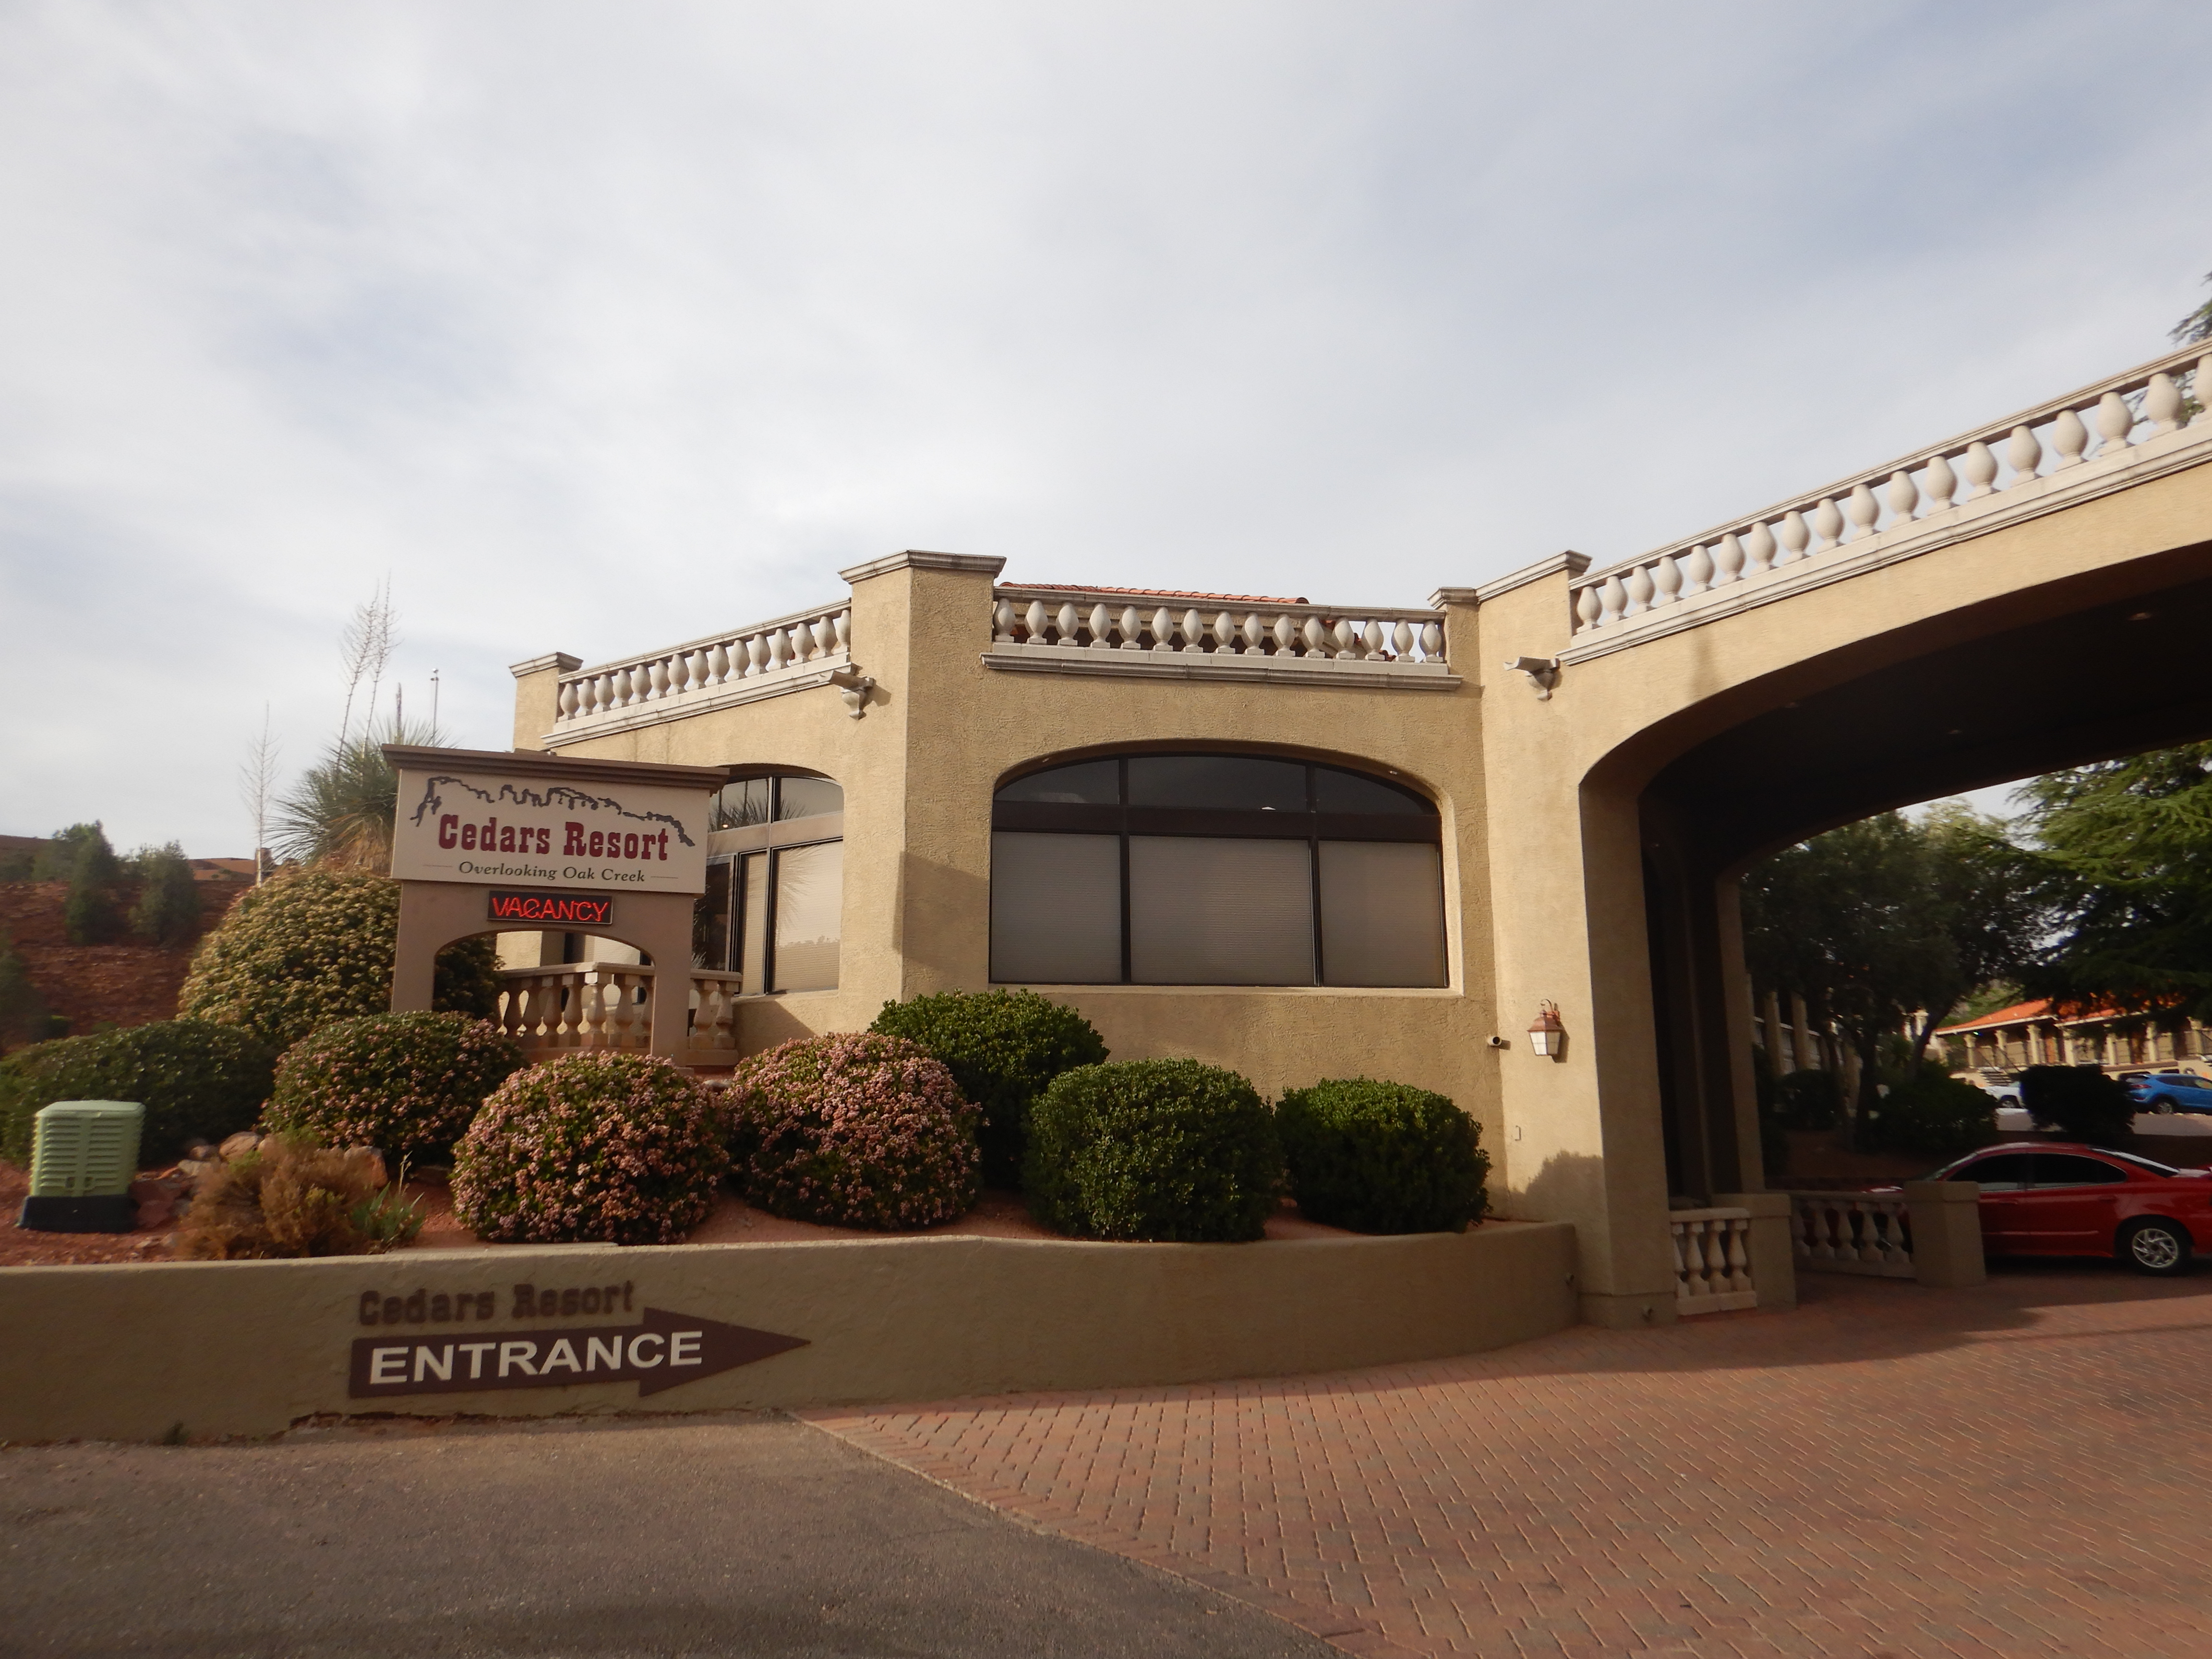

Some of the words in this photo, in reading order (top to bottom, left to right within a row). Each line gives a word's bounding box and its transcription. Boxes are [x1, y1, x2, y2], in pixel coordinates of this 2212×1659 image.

[438, 813, 551, 855] Cedars
[563, 821, 669, 861] Resort
[458, 860, 557, 881] Overlooking
[563, 866, 595, 880] Oak
[601, 868, 646, 882] Creek
[492, 896, 610, 922] VACANCY
[358, 1287, 495, 1326] Cedars
[512, 1280, 635, 1319] Resort
[369, 1330, 704, 1385] ENTRANCE
